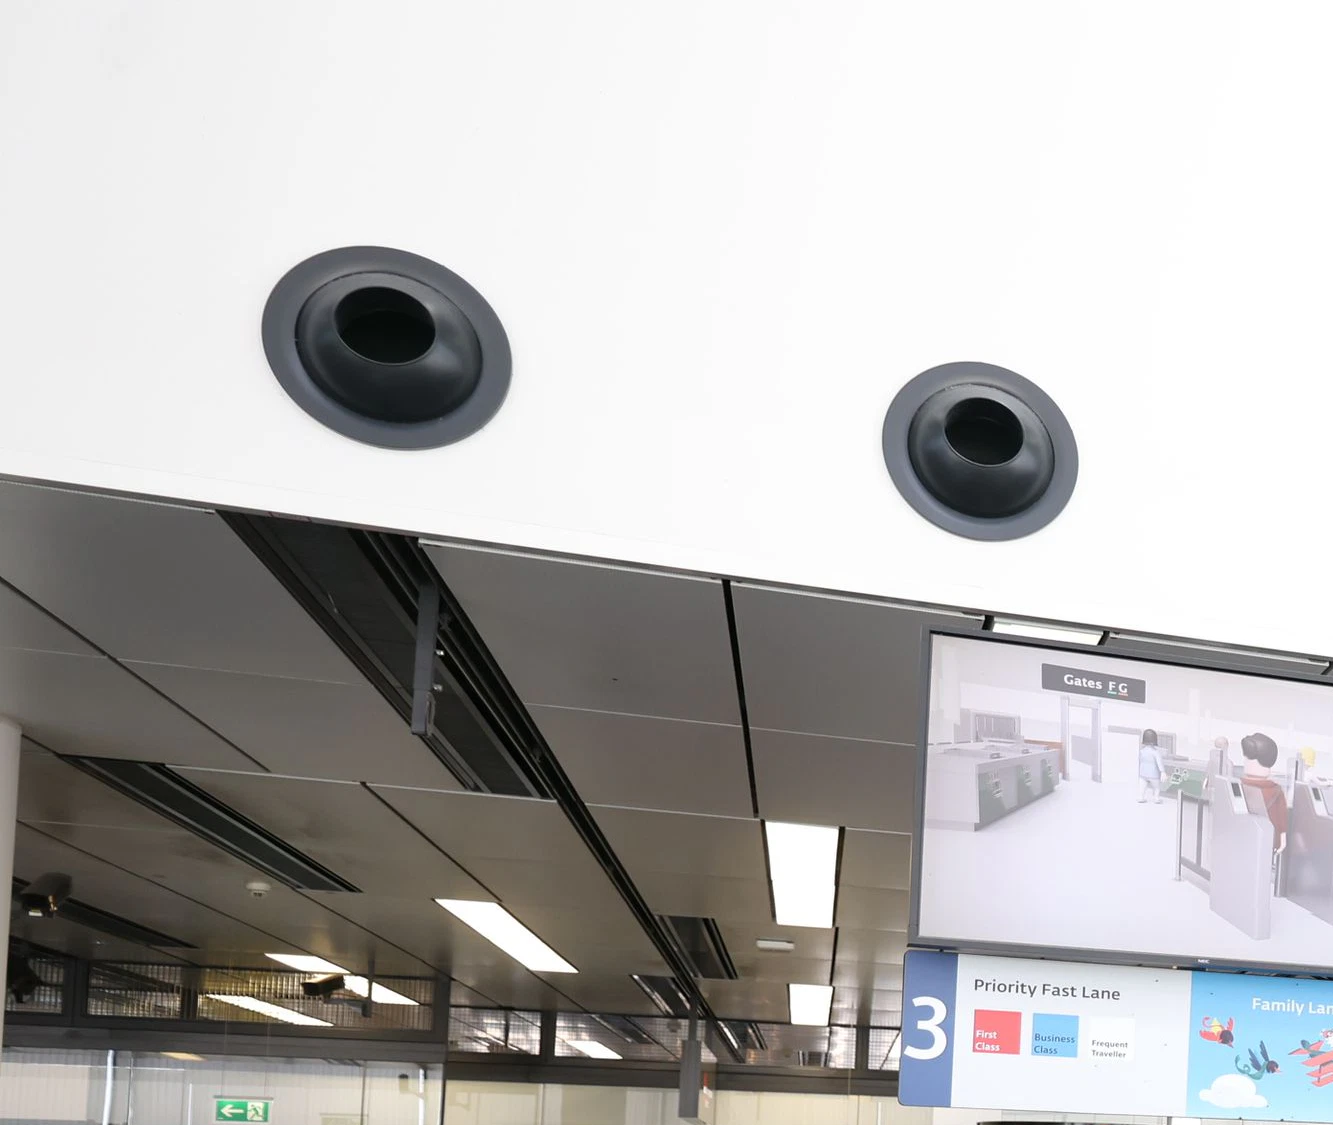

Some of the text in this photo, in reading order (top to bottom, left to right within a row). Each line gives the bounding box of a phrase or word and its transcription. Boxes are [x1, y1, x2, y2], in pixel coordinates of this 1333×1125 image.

[1063, 674, 1103, 690] Gates
[973, 978, 1121, 1001] Priority Fast Lane
[1252, 998, 1304, 1015] Family
[903, 995, 947, 1060] 3
[976, 1030, 998, 1040] First
[1034, 1033, 1076, 1044] Business
[975, 1042, 1001, 1052] Class
[1033, 1045, 1058, 1055] Class
[1091, 1040, 1128, 1050] Frequent
[1091, 1049, 1126, 1058] Traveller
